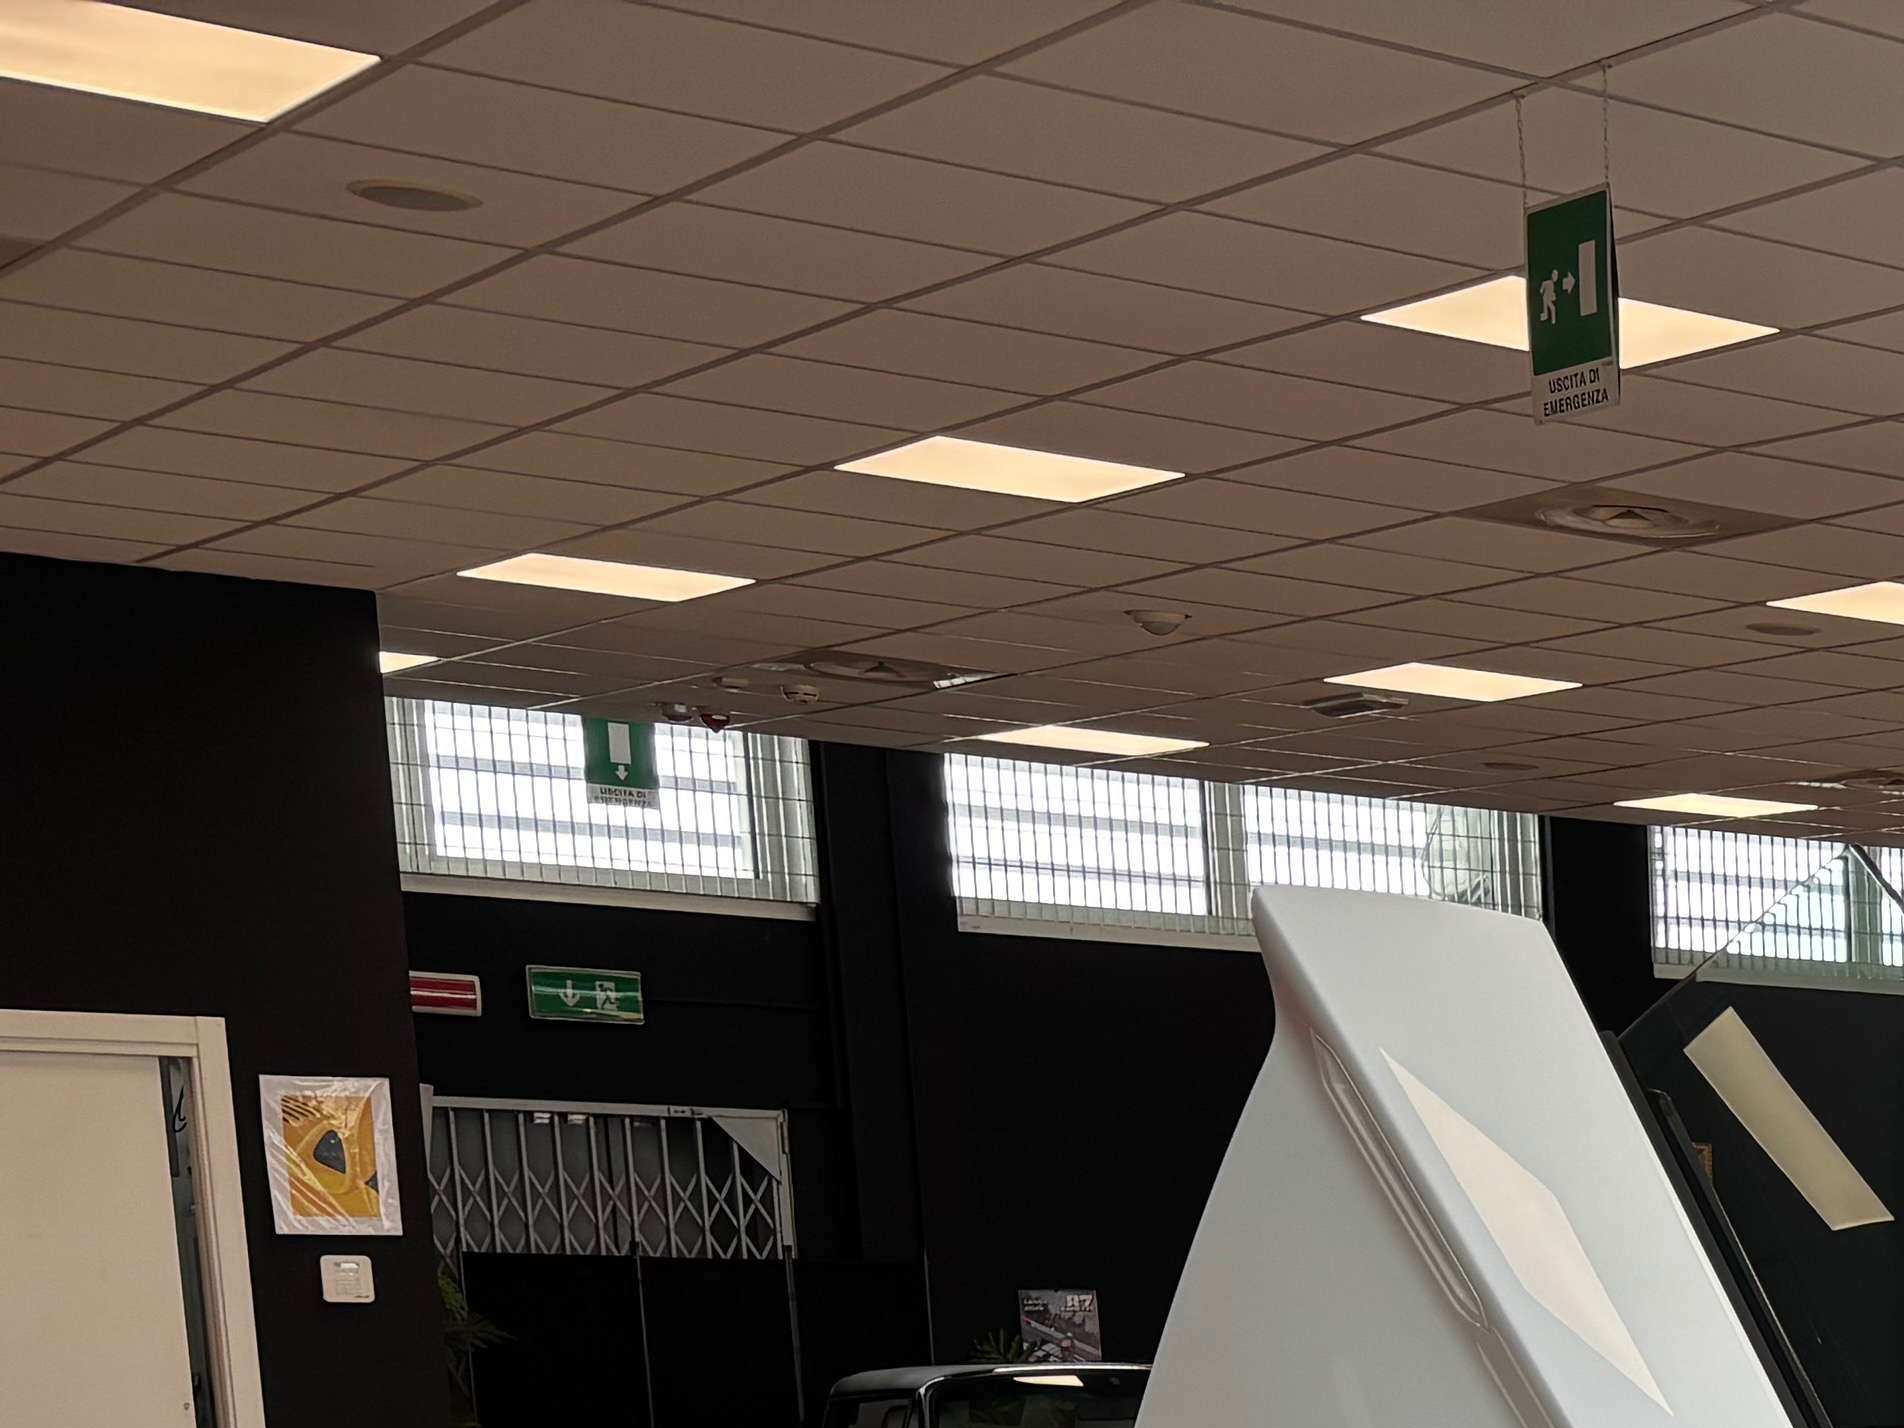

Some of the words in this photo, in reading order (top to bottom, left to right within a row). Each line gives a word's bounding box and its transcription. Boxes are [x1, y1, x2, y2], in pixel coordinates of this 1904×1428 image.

[1548, 370, 1588, 394] USCITA
[1588, 368, 1600, 386] DI
[1543, 388, 1609, 417] EMERGENZA
